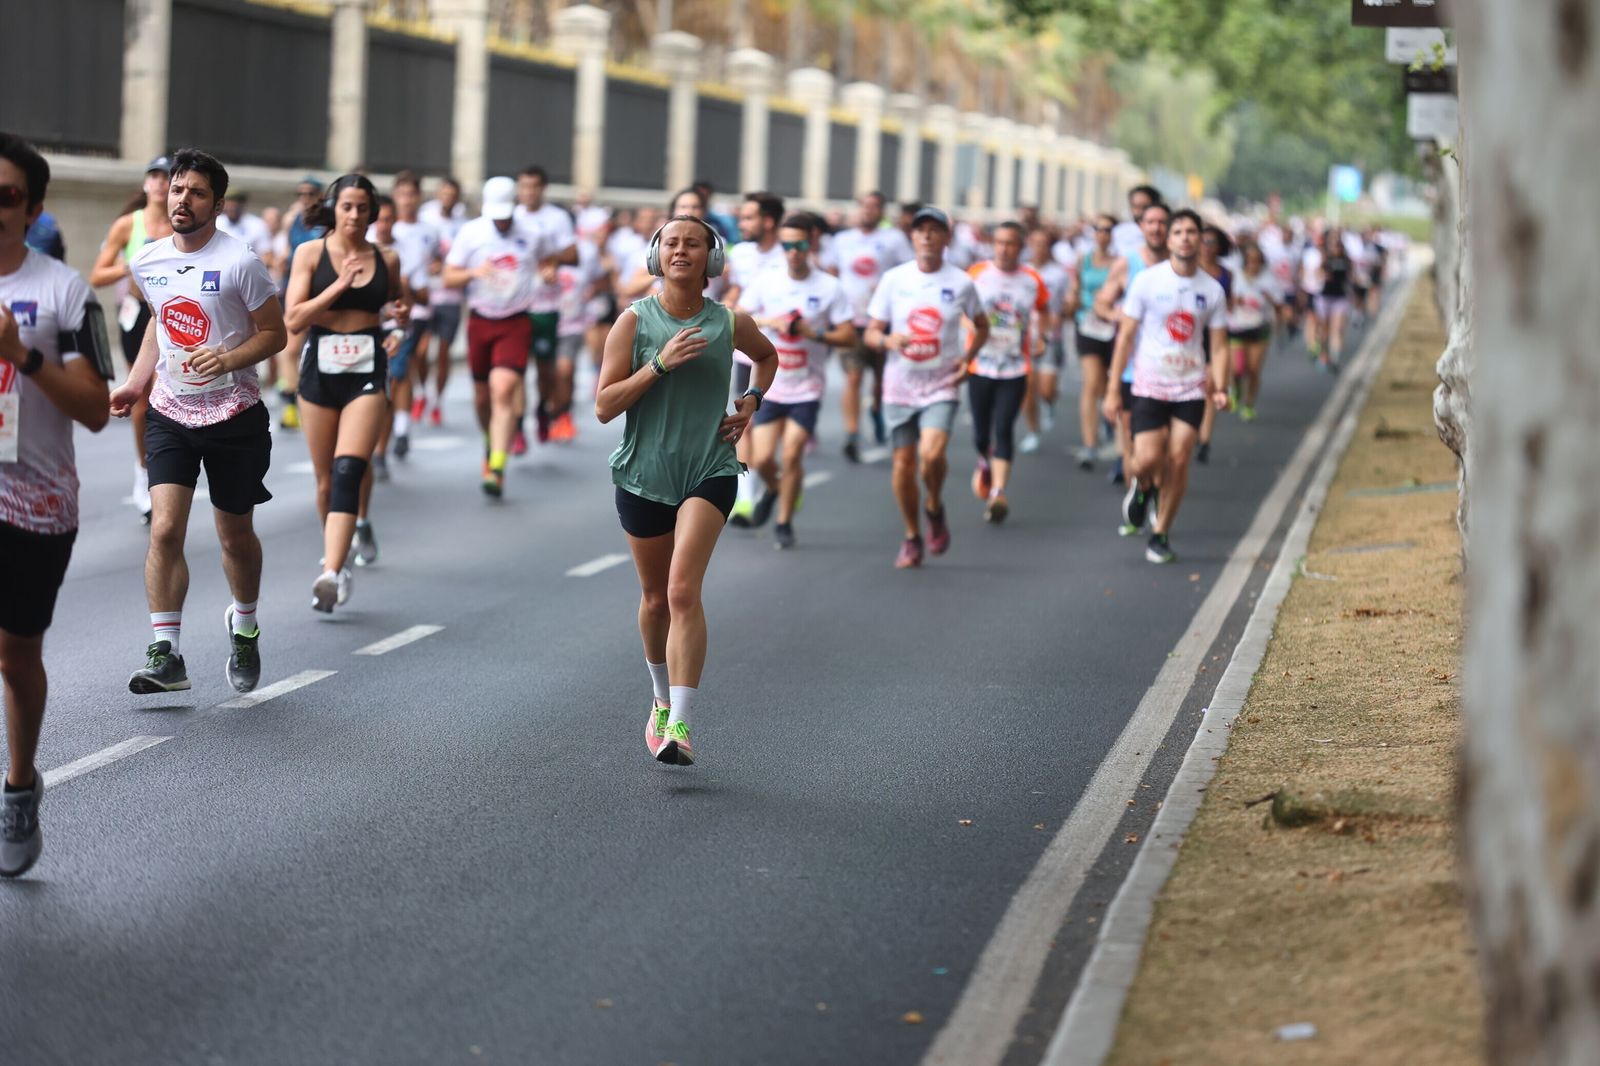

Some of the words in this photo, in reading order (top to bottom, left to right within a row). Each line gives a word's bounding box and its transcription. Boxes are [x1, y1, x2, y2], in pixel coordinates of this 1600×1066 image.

[201, 281, 216, 289] AXA
[168, 309, 203, 328] PONLE
[166, 318, 202, 337] FRENO
[333, 345, 359, 354] 131
